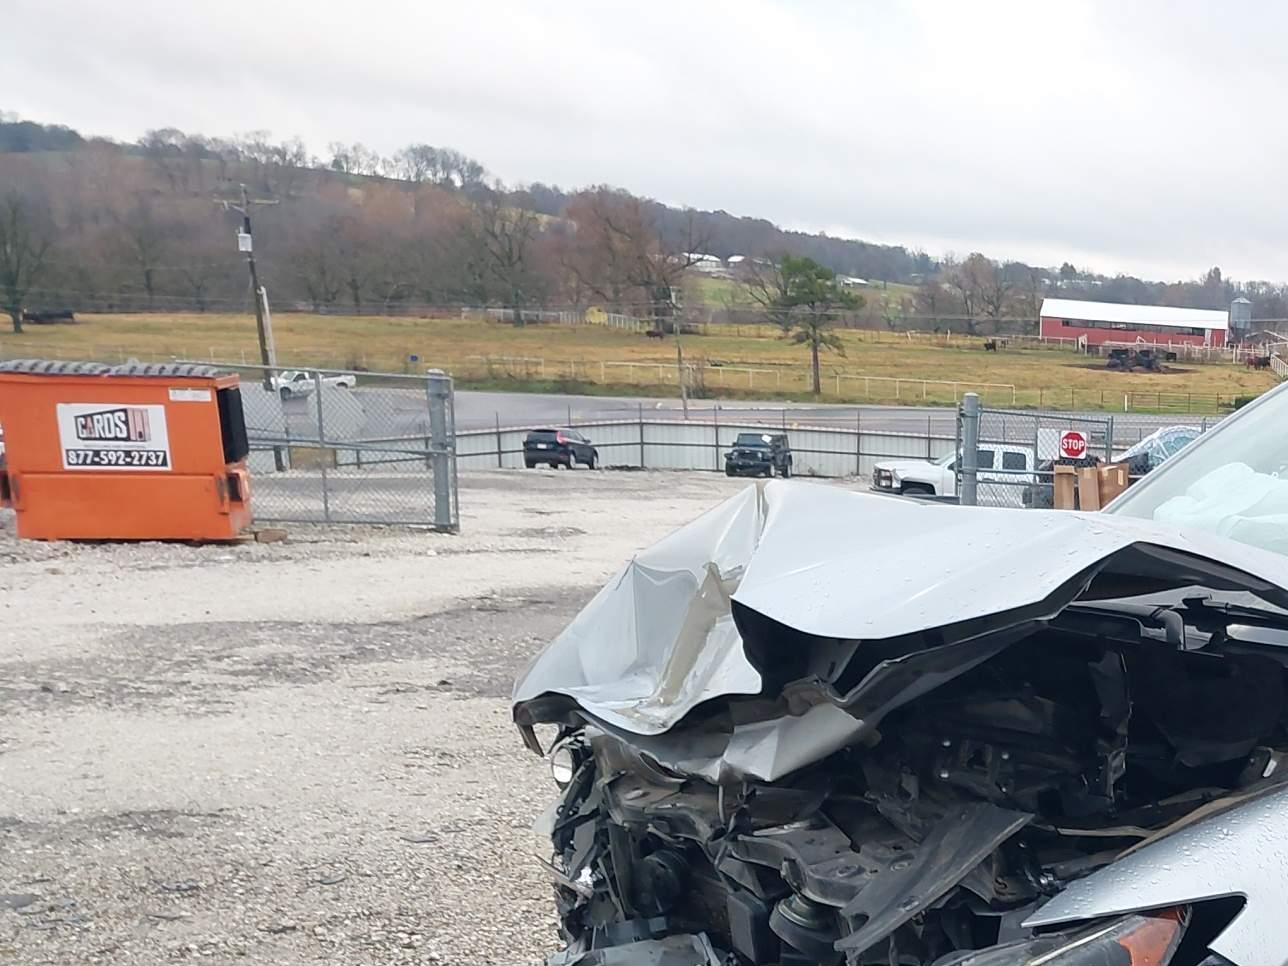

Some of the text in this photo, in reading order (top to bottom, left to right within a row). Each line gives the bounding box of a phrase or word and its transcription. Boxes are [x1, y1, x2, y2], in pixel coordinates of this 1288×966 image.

[77, 412, 128, 438] CARDS
[1062, 439, 1085, 451] STOP
[68, 450, 165, 465] 877-592-2737
